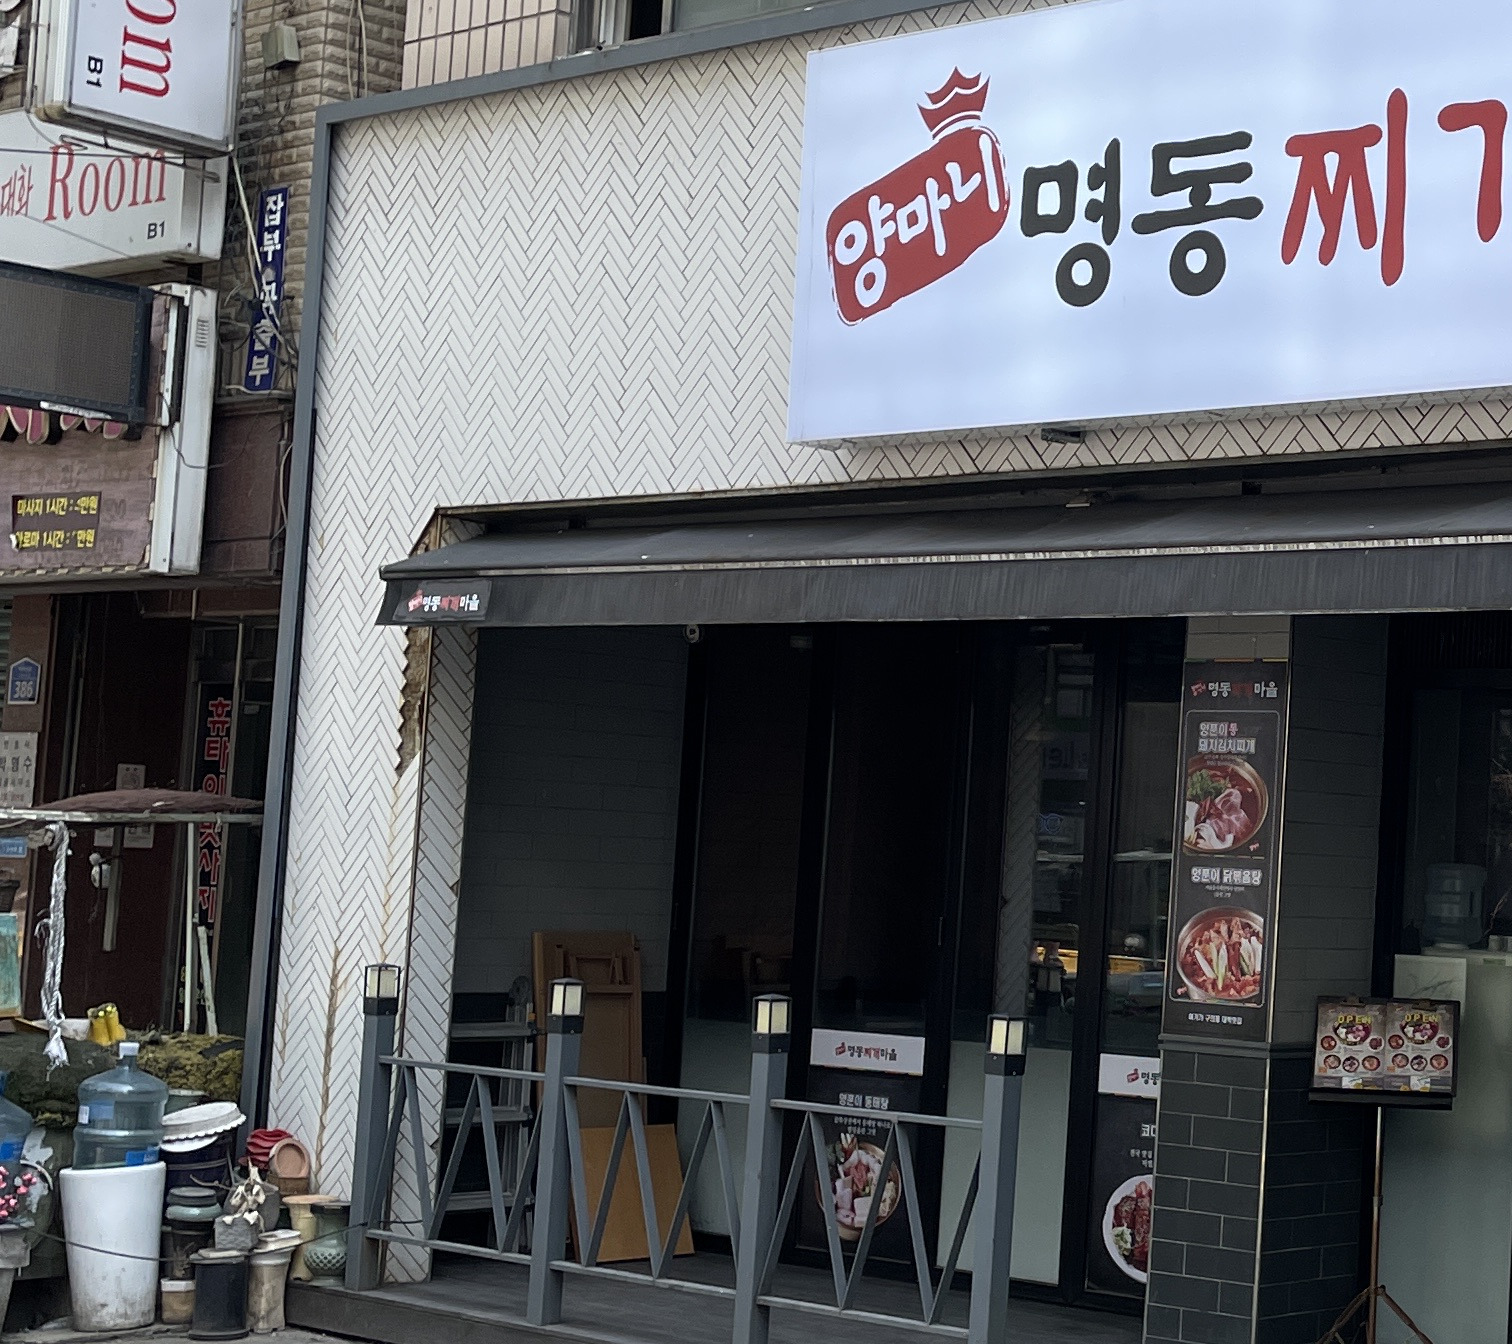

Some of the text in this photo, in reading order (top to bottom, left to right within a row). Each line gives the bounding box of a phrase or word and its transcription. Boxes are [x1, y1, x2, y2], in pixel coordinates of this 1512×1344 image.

[85, 55, 104, 90] B1
[43, 143, 167, 224] Room
[147, 220, 166, 240] B1
[834, 133, 1000, 309] 양마니
[13, 680, 34, 700] 386
